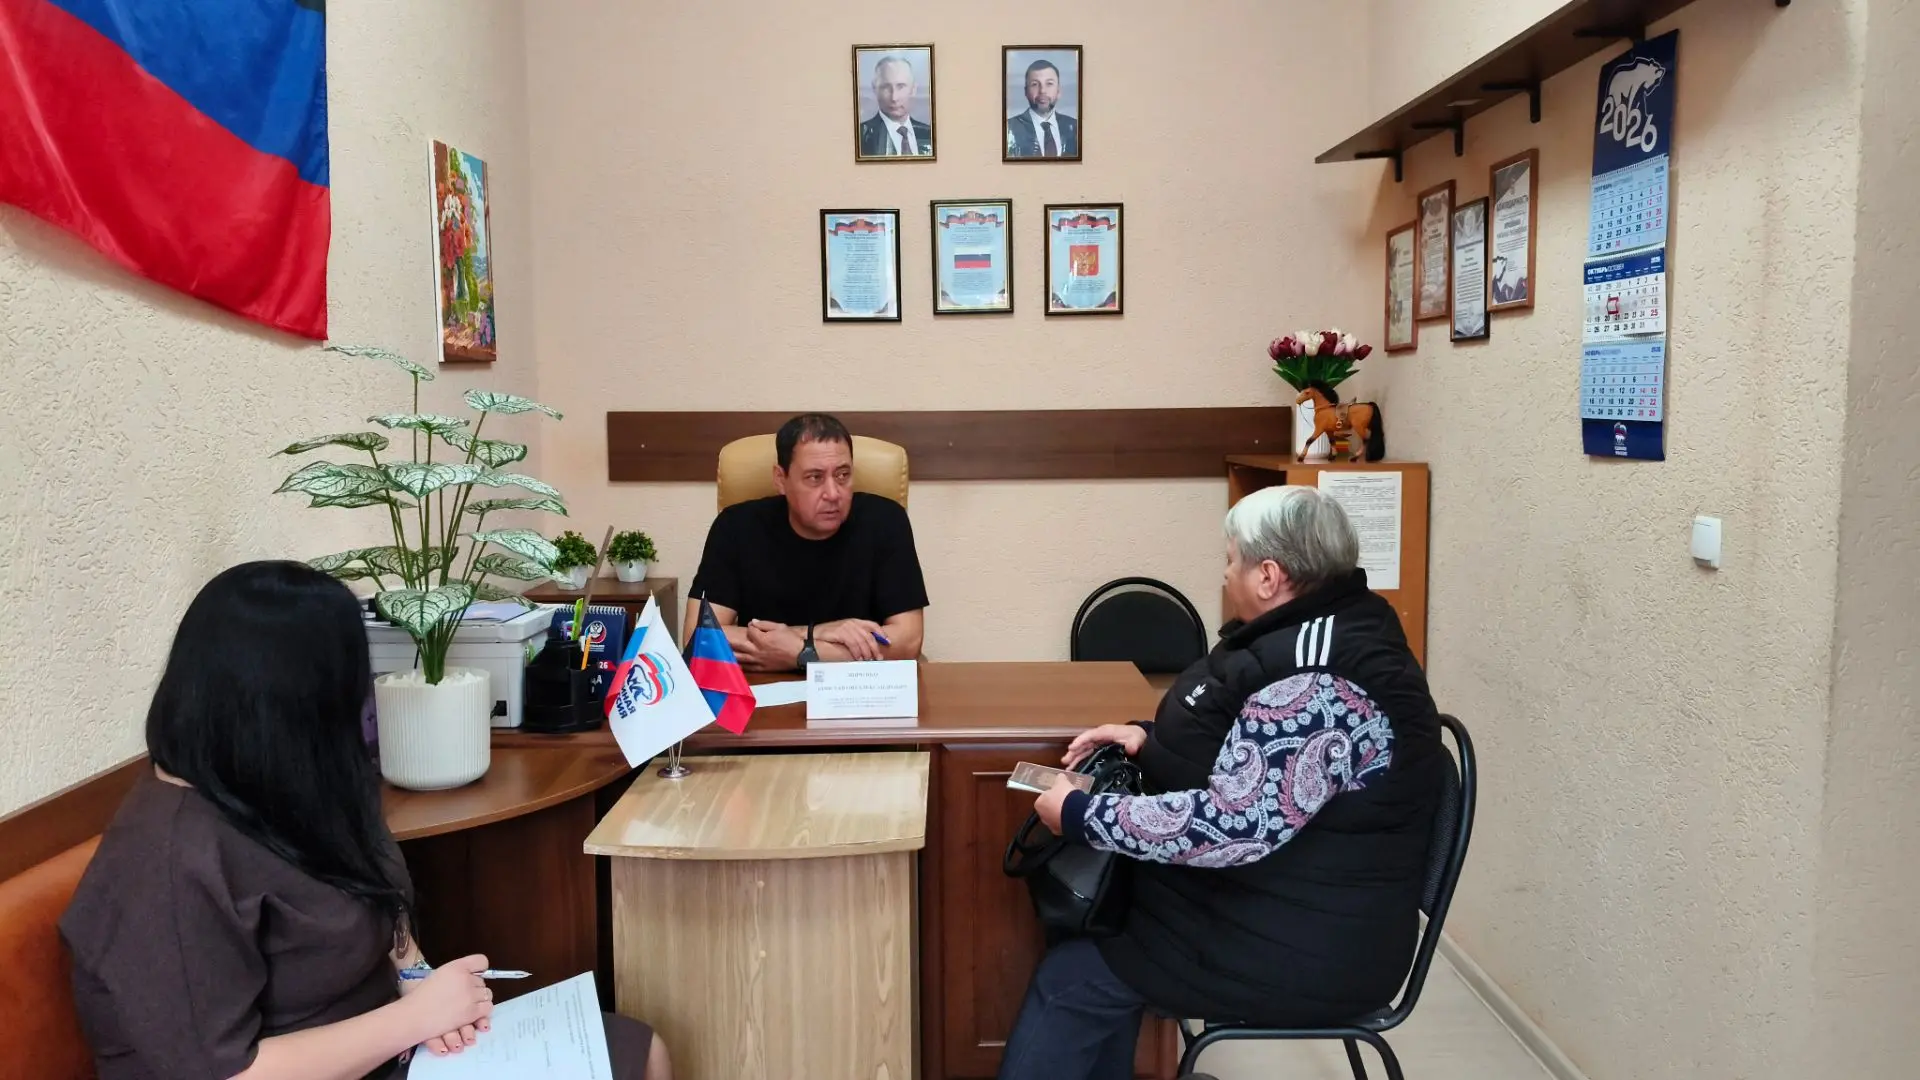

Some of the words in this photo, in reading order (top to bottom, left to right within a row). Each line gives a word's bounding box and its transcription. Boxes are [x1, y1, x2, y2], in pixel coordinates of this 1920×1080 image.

[1600, 95, 1658, 153] 2026
[599, 661, 609, 669] 26
[616, 698, 628, 719] СИЯ
[620, 686, 636, 714] ИНАЯ
